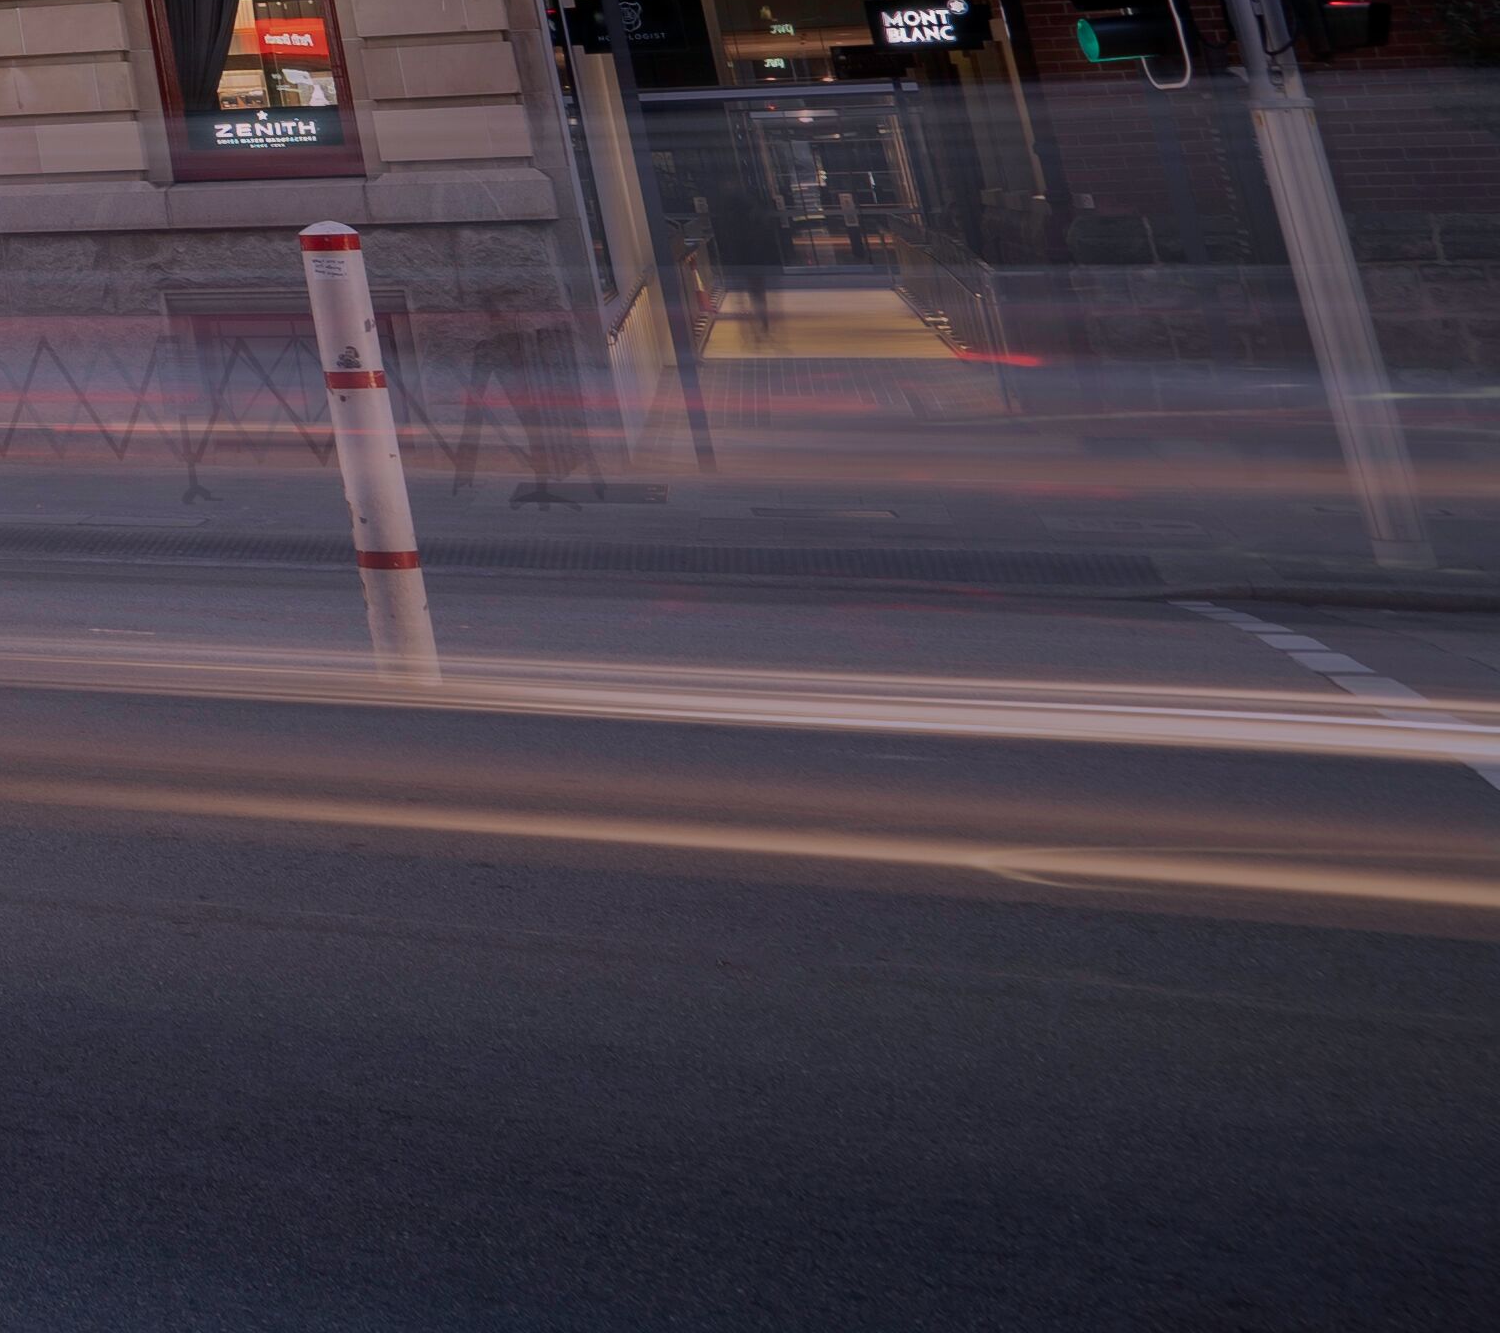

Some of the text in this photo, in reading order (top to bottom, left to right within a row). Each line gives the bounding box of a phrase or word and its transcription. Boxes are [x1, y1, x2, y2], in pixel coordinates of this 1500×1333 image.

[881, 9, 950, 28] MONT
[885, 25, 957, 44] BLANC
[214, 121, 317, 138] ZENITH
